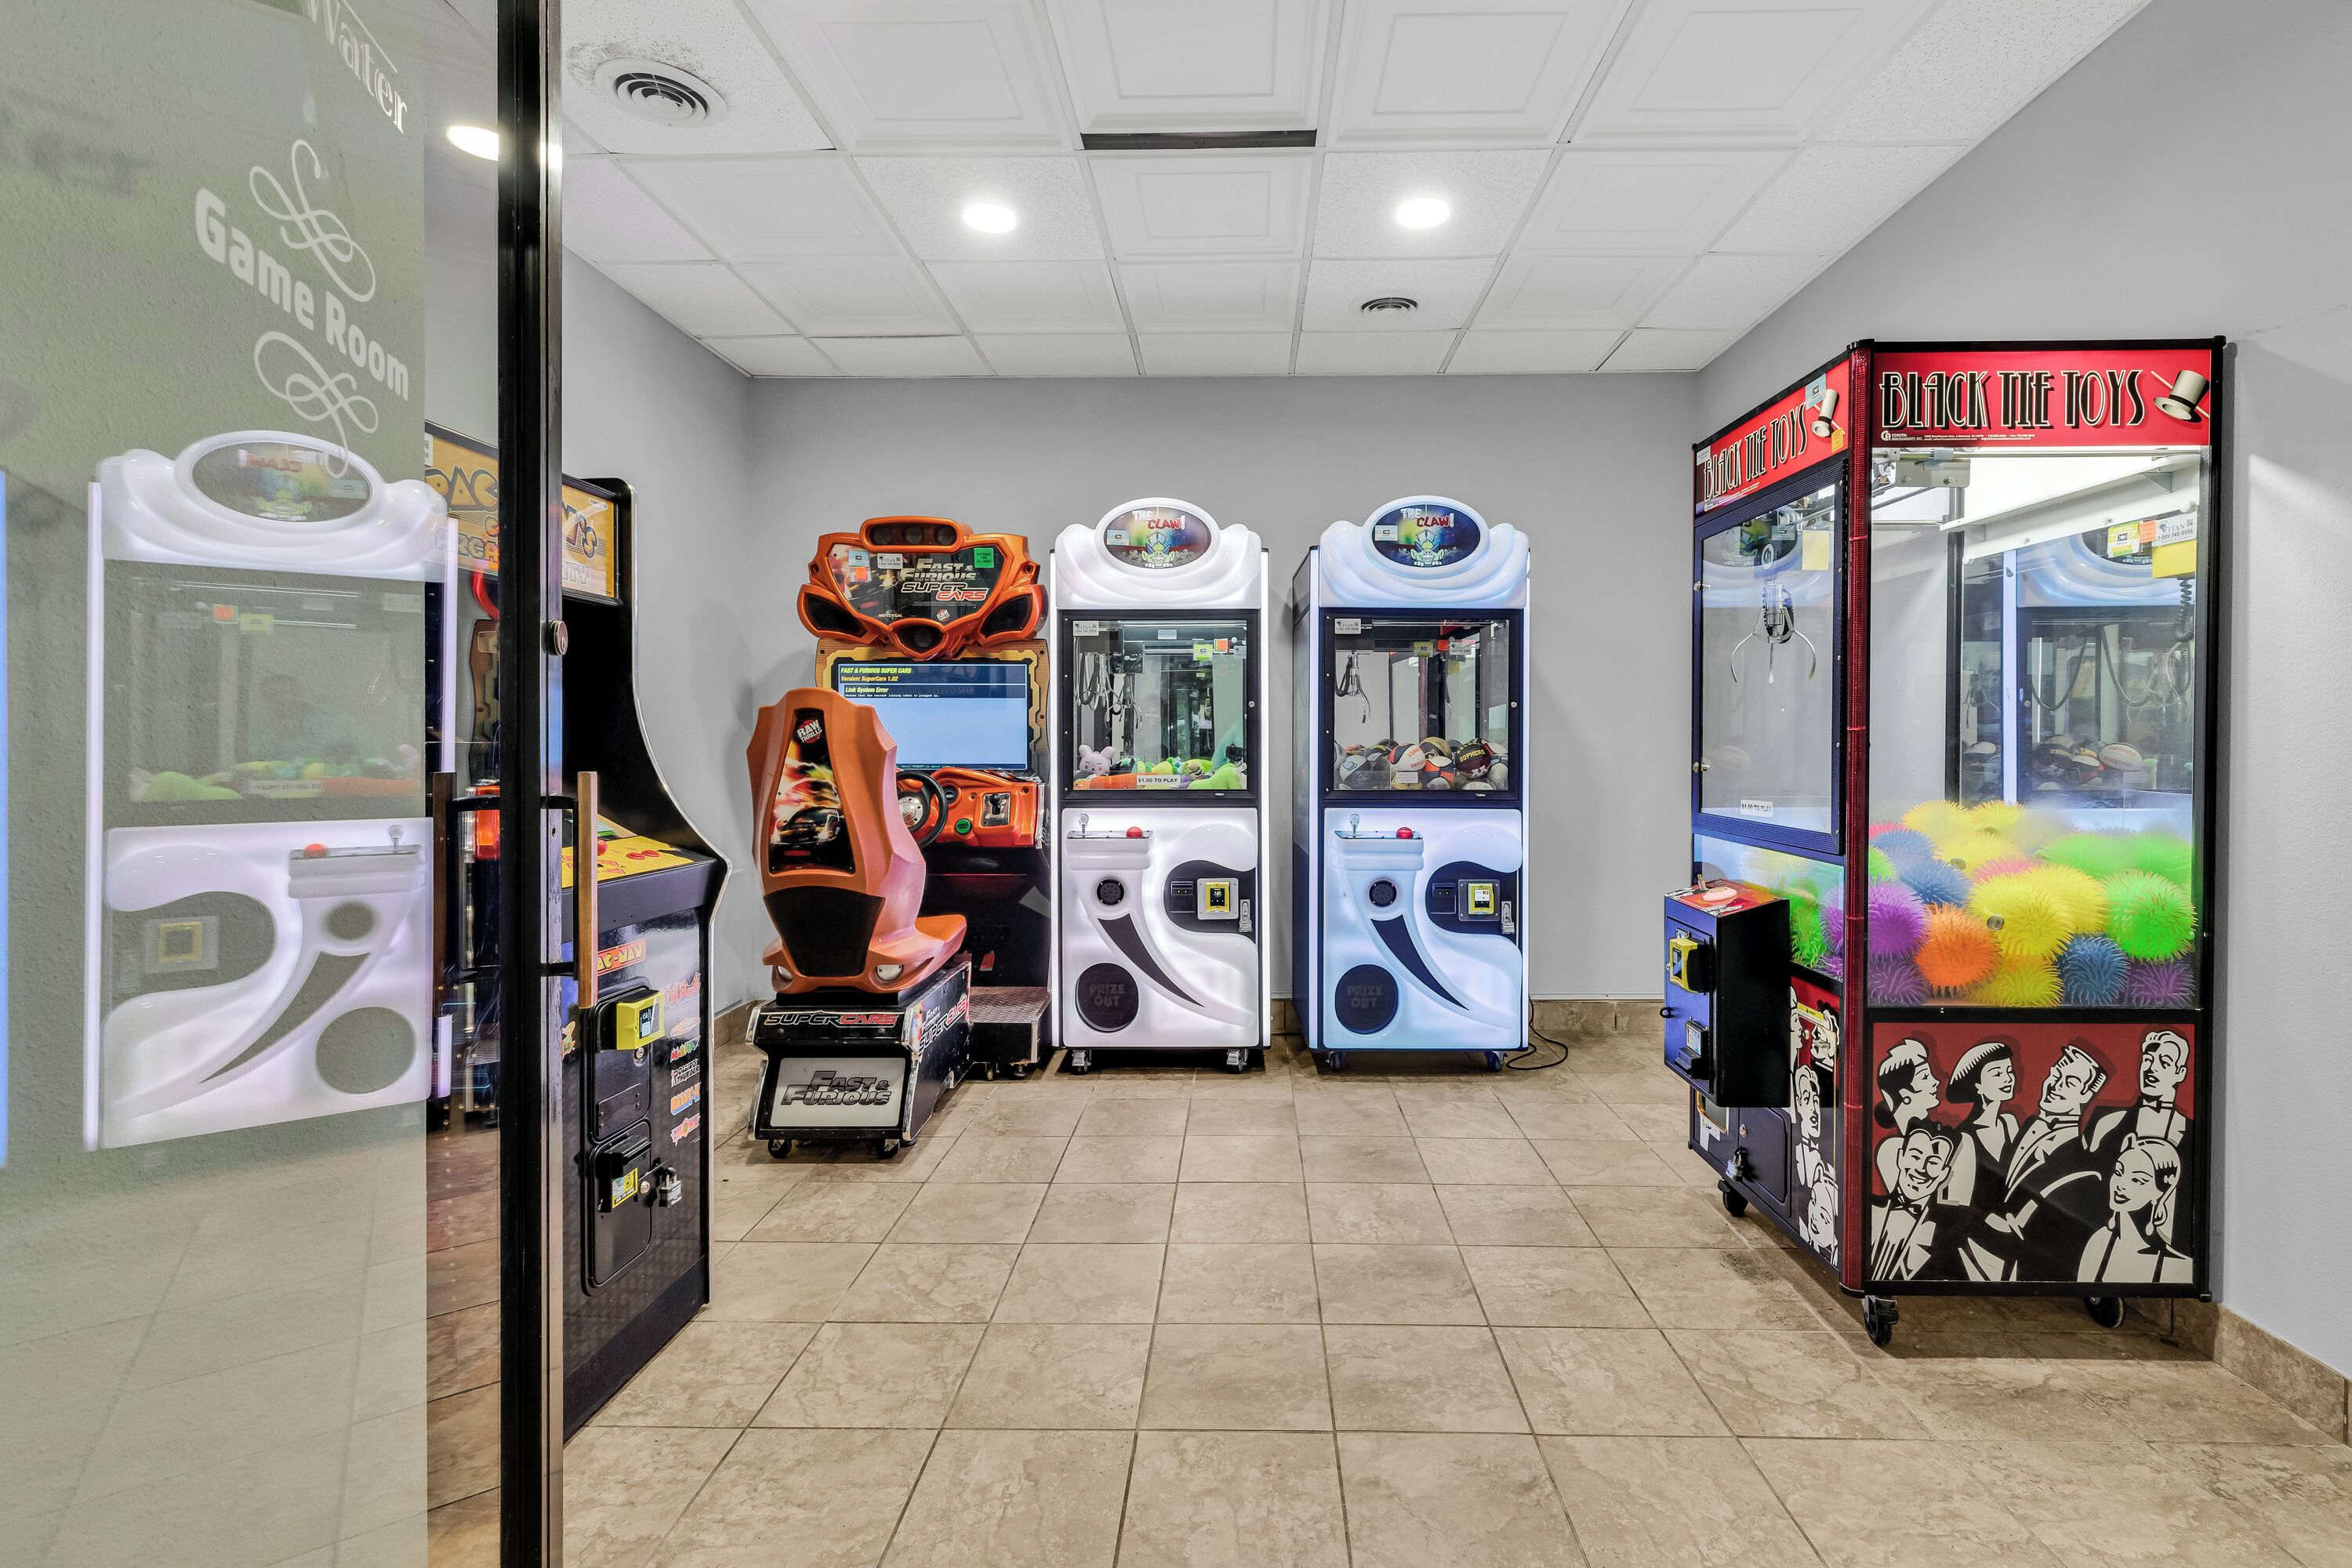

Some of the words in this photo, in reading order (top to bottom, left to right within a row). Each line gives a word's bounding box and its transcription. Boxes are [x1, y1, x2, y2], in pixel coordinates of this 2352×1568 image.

[195, 188, 314, 330] Game
[325, 291, 408, 401] Room
[1879, 371, 1988, 428] BLACK
[1997, 370, 2053, 428] TIE
[2060, 369, 2145, 427] TOYS
[1704, 440, 1742, 502] BLACK
[1744, 426, 1767, 481] TIE
[1769, 401, 1808, 469] TOYS
[1131, 510, 1153, 521] THE
[1400, 508, 1423, 521] THE
[1416, 513, 1454, 528] CLAW!
[1147, 515, 1185, 530] CLAW!
[916, 558, 964, 572] FAST
[898, 568, 977, 582] FURIOUS
[901, 582, 968, 593] SUPER
[936, 589, 989, 601] CARS
[797, 720, 819, 739] RAW
[800, 728, 822, 742] THRILLS
[1459, 749, 1486, 762] GOPHERS
[597, 945, 643, 971] AC-MAN
[1088, 983, 1126, 996] PRIZE
[1346, 985, 1384, 996] PRIZE
[1094, 995, 1120, 1007] OUT
[1351, 996, 1377, 1008] OUT
[808, 1070, 877, 1091] FAST
[875, 1080, 891, 1091] &
[780, 1084, 892, 1105] FURIOUS
